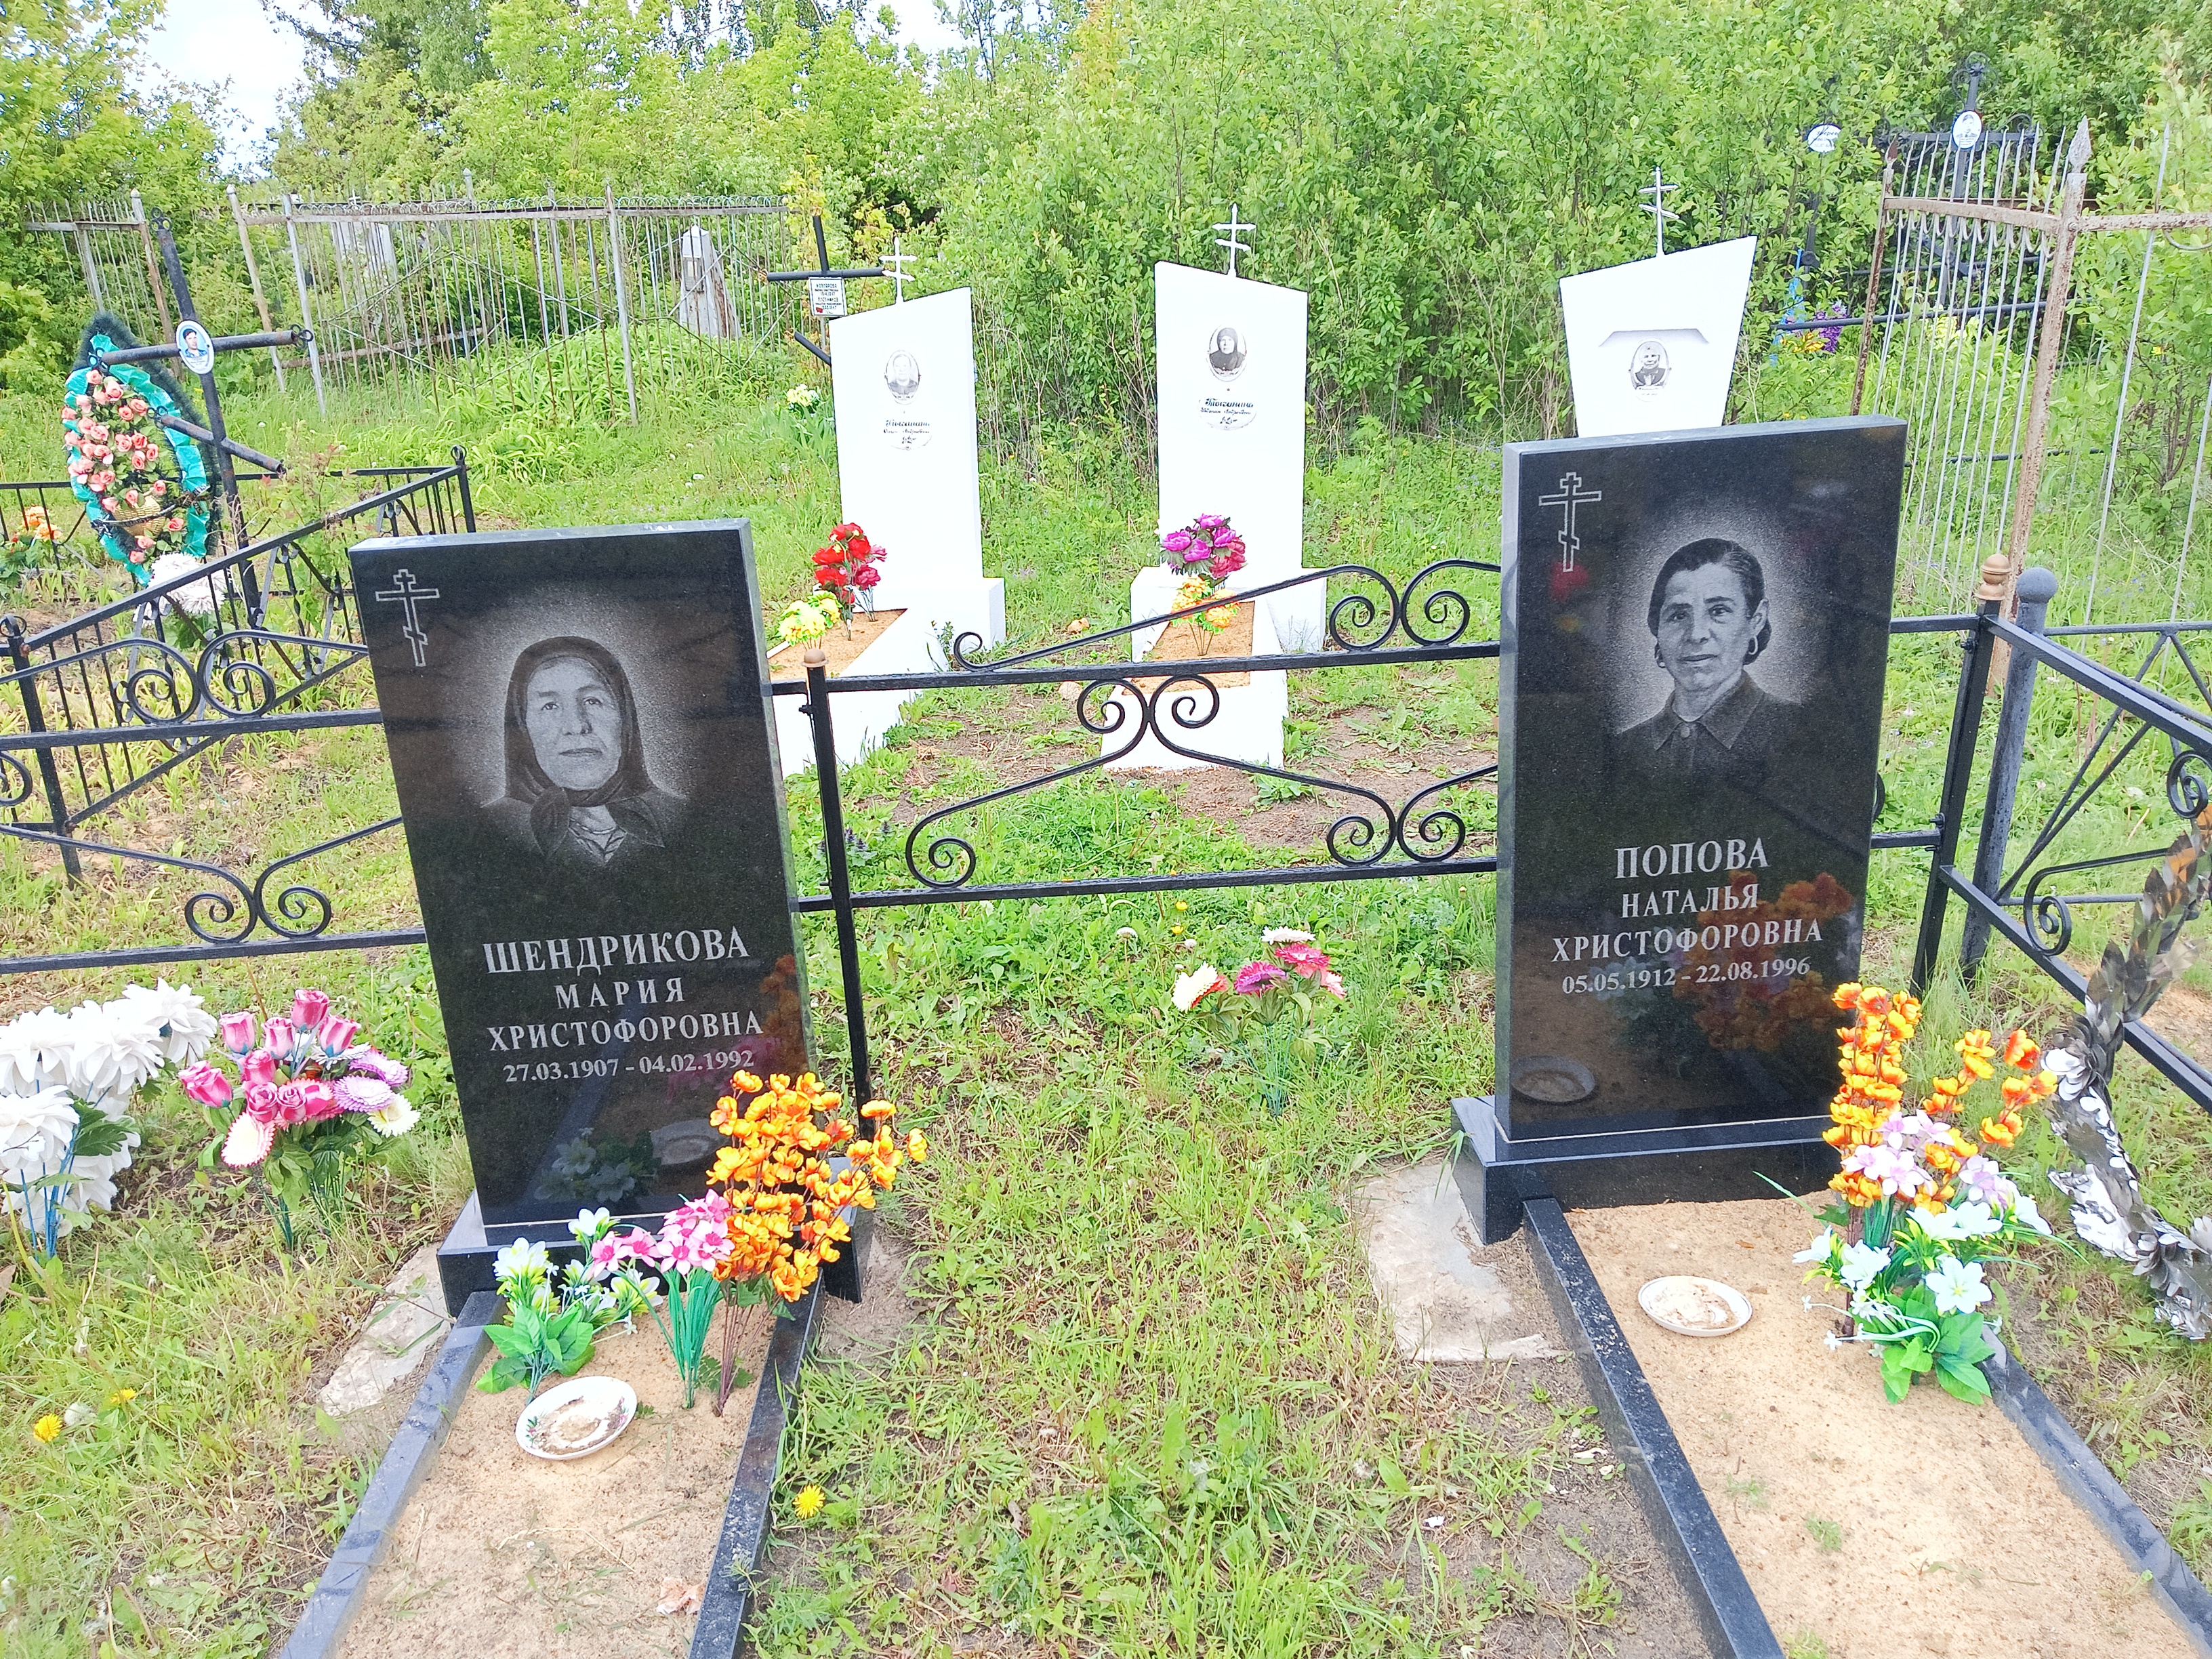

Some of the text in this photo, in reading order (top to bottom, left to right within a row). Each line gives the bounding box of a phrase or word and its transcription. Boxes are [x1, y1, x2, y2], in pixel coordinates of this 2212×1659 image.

[1615, 837, 1769, 879] ПОПОВА
[1622, 883, 1759, 918] НАТАЛЬЯ
[483, 926, 750, 976] ШЕНДРИКОВА
[1552, 918, 1822, 962] ХРИСТОФОРОВНА
[554, 977, 685, 1009] МАРИЯ
[1562, 968, 1677, 994] 05.05.1912
[1696, 956, 1810, 983] 22.08.1996
[487, 1010, 764, 1052] ХРИСТОФОРОВНА
[503, 1059, 619, 1082] 27.03.1907
[639, 1050, 755, 1074] 04.02.1992
